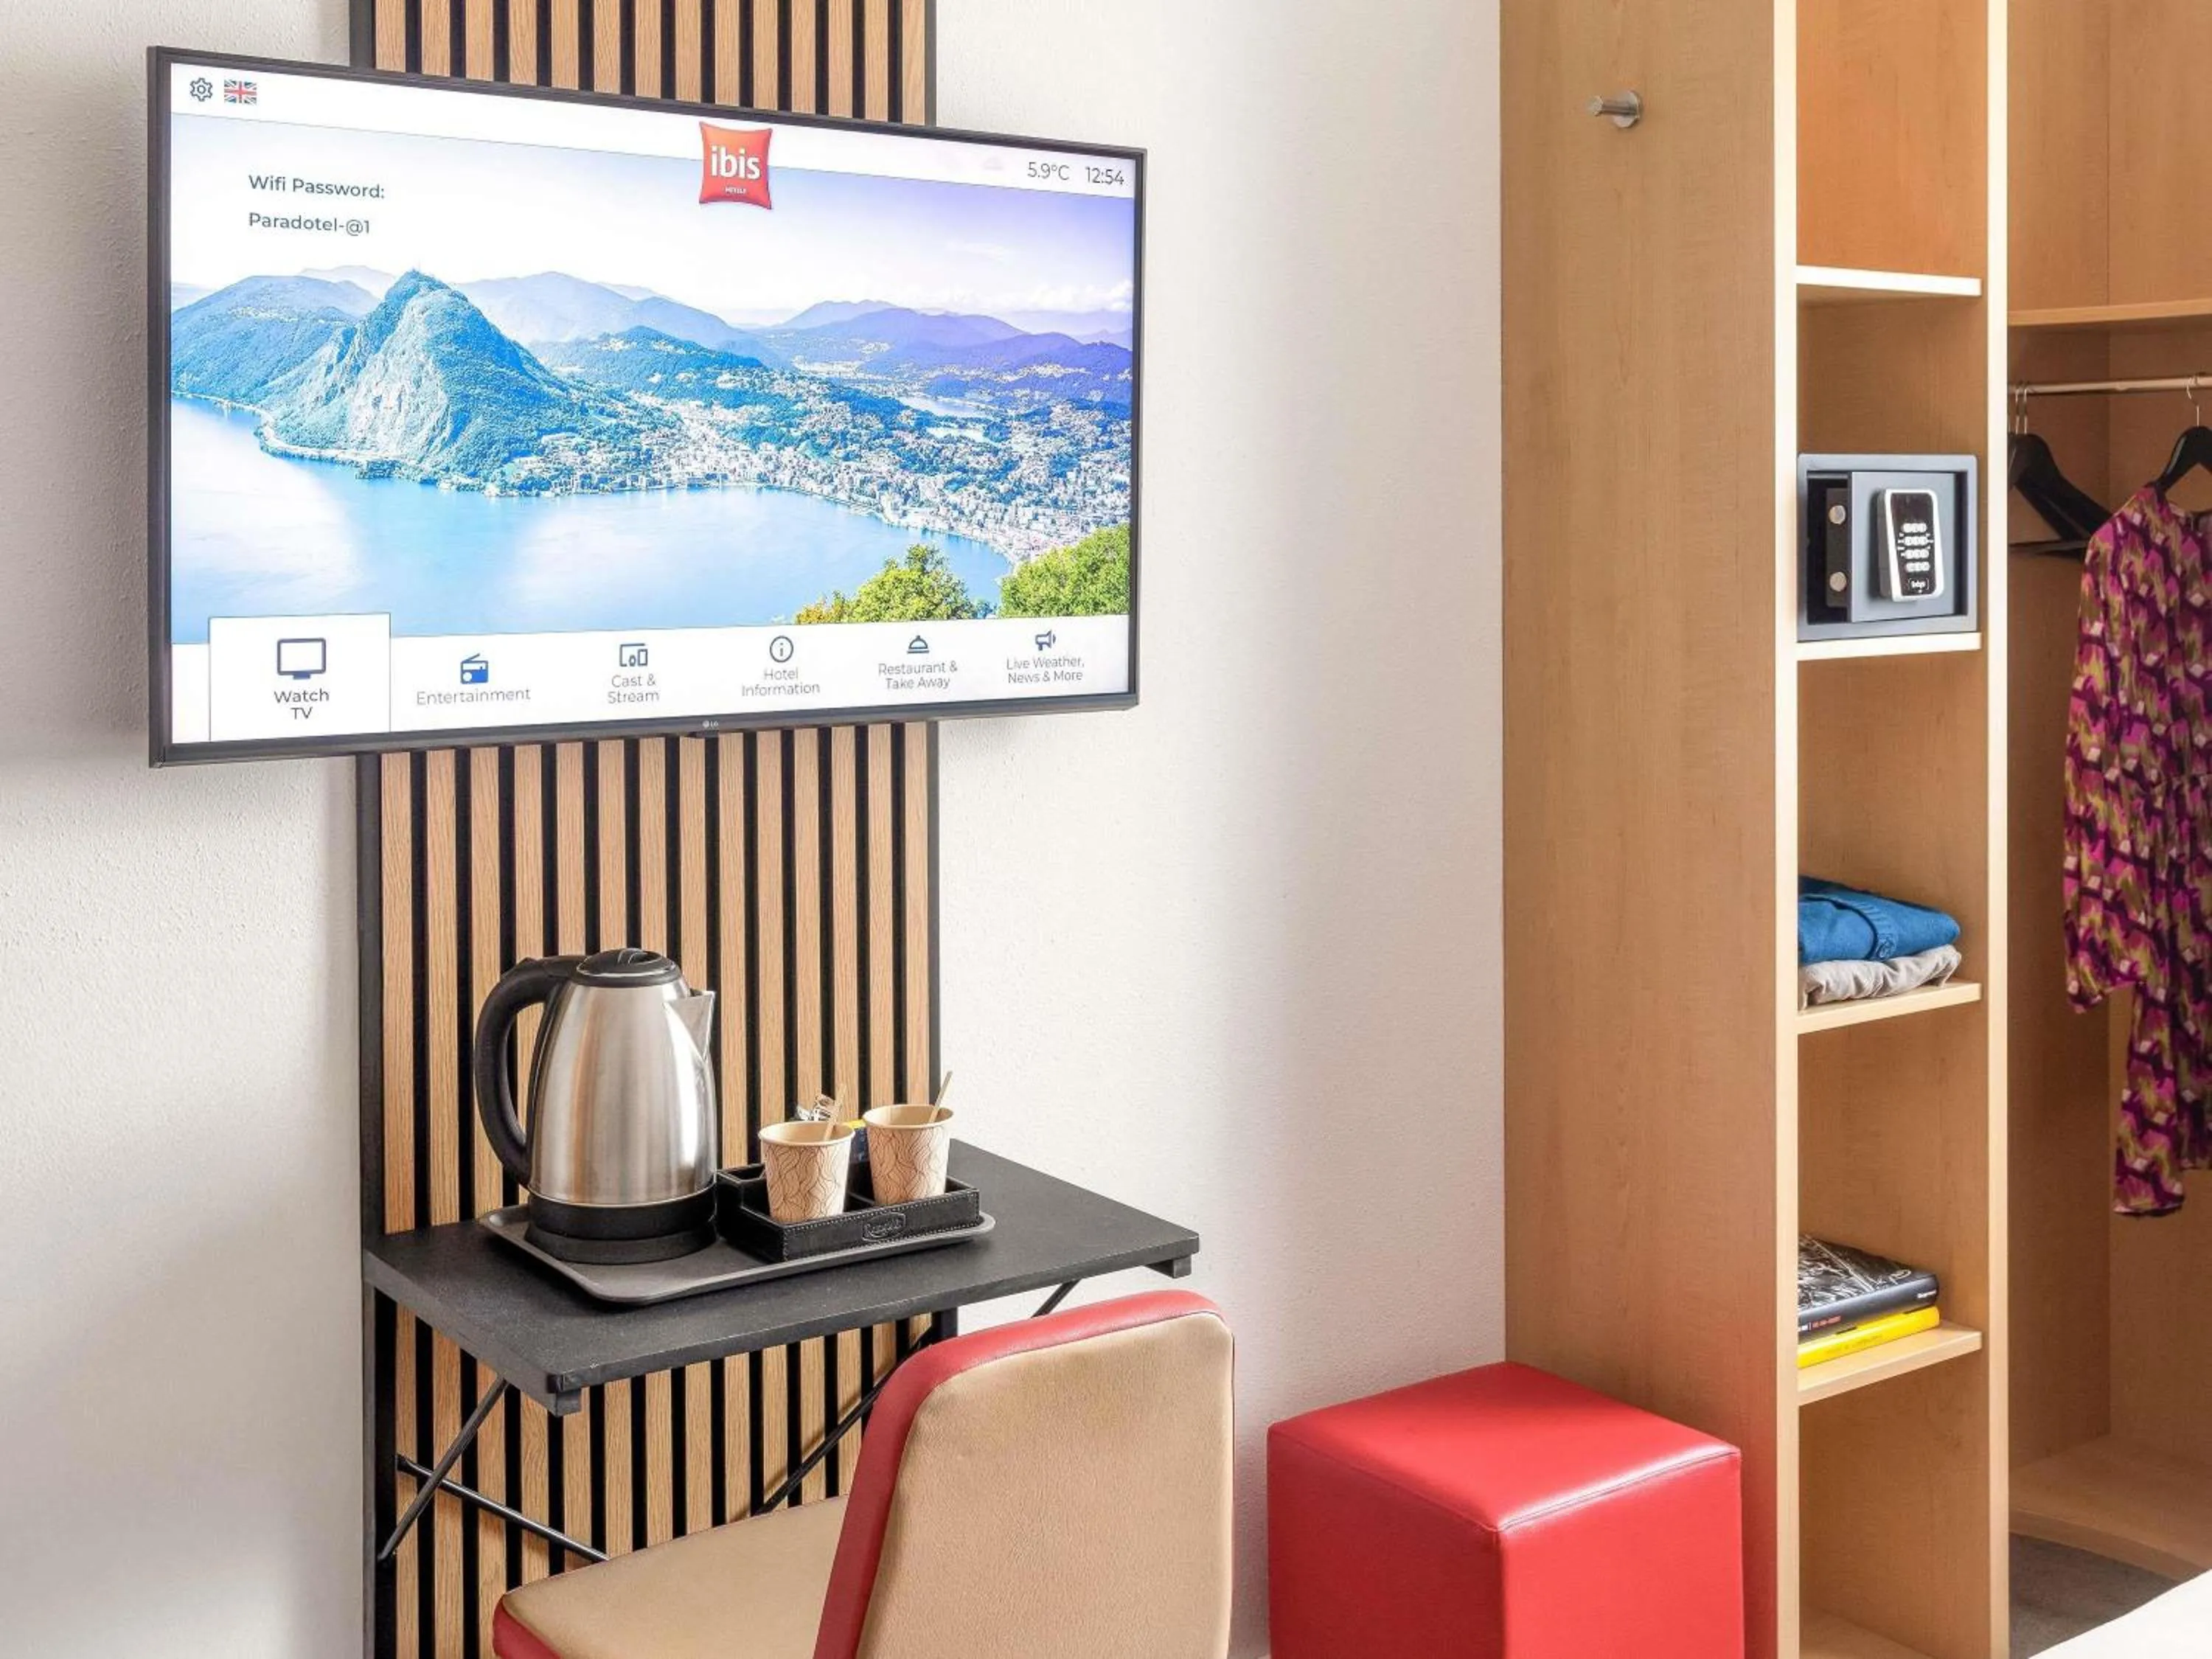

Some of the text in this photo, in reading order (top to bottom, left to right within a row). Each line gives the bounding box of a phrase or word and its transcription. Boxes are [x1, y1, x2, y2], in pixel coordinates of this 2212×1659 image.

[711, 145, 761, 180] ibis
[1027, 161, 1125, 185] 5.9°C 12:54
[248, 174, 385, 200] Wifi Password:
[248, 212, 370, 237] Paradotel-@1
[877, 661, 958, 675] Restaurant &
[1006, 658, 1030, 670] Live
[611, 673, 657, 689] Cast &
[763, 667, 799, 681] Hotel
[1007, 669, 1083, 684] News & More
[741, 680, 821, 697] Information
[885, 676, 950, 691] Take Away
[274, 687, 330, 704] Watch
[416, 686, 531, 706] Entertainment
[608, 687, 661, 704] Stream
[290, 706, 314, 720] TV
